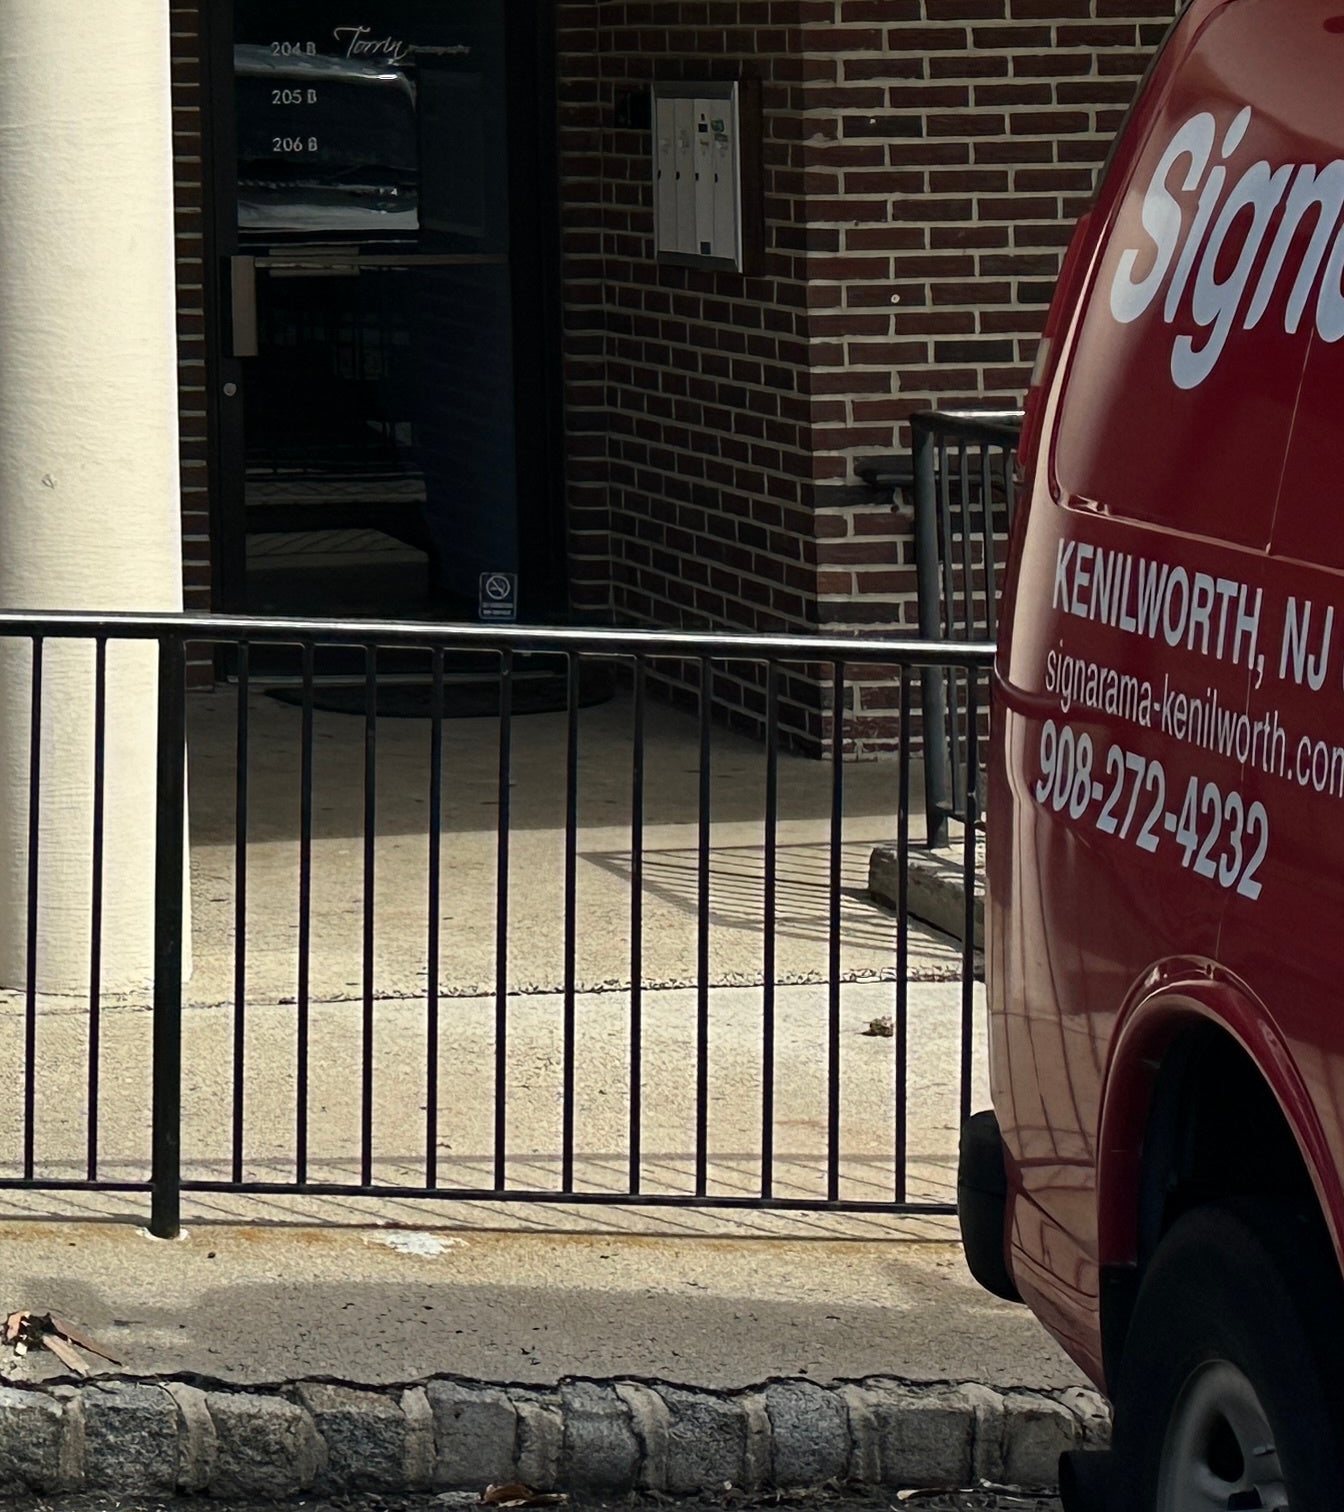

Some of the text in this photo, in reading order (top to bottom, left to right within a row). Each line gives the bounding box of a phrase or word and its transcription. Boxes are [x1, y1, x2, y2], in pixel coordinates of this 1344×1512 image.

[270, 41, 317, 56] 204 B
[271, 88, 318, 104] 205 B
[272, 136, 318, 152] 206 B
[1052, 537, 1334, 691] KENILWORTH, NJ
[1036, 719, 1269, 901] 908-272-4232
